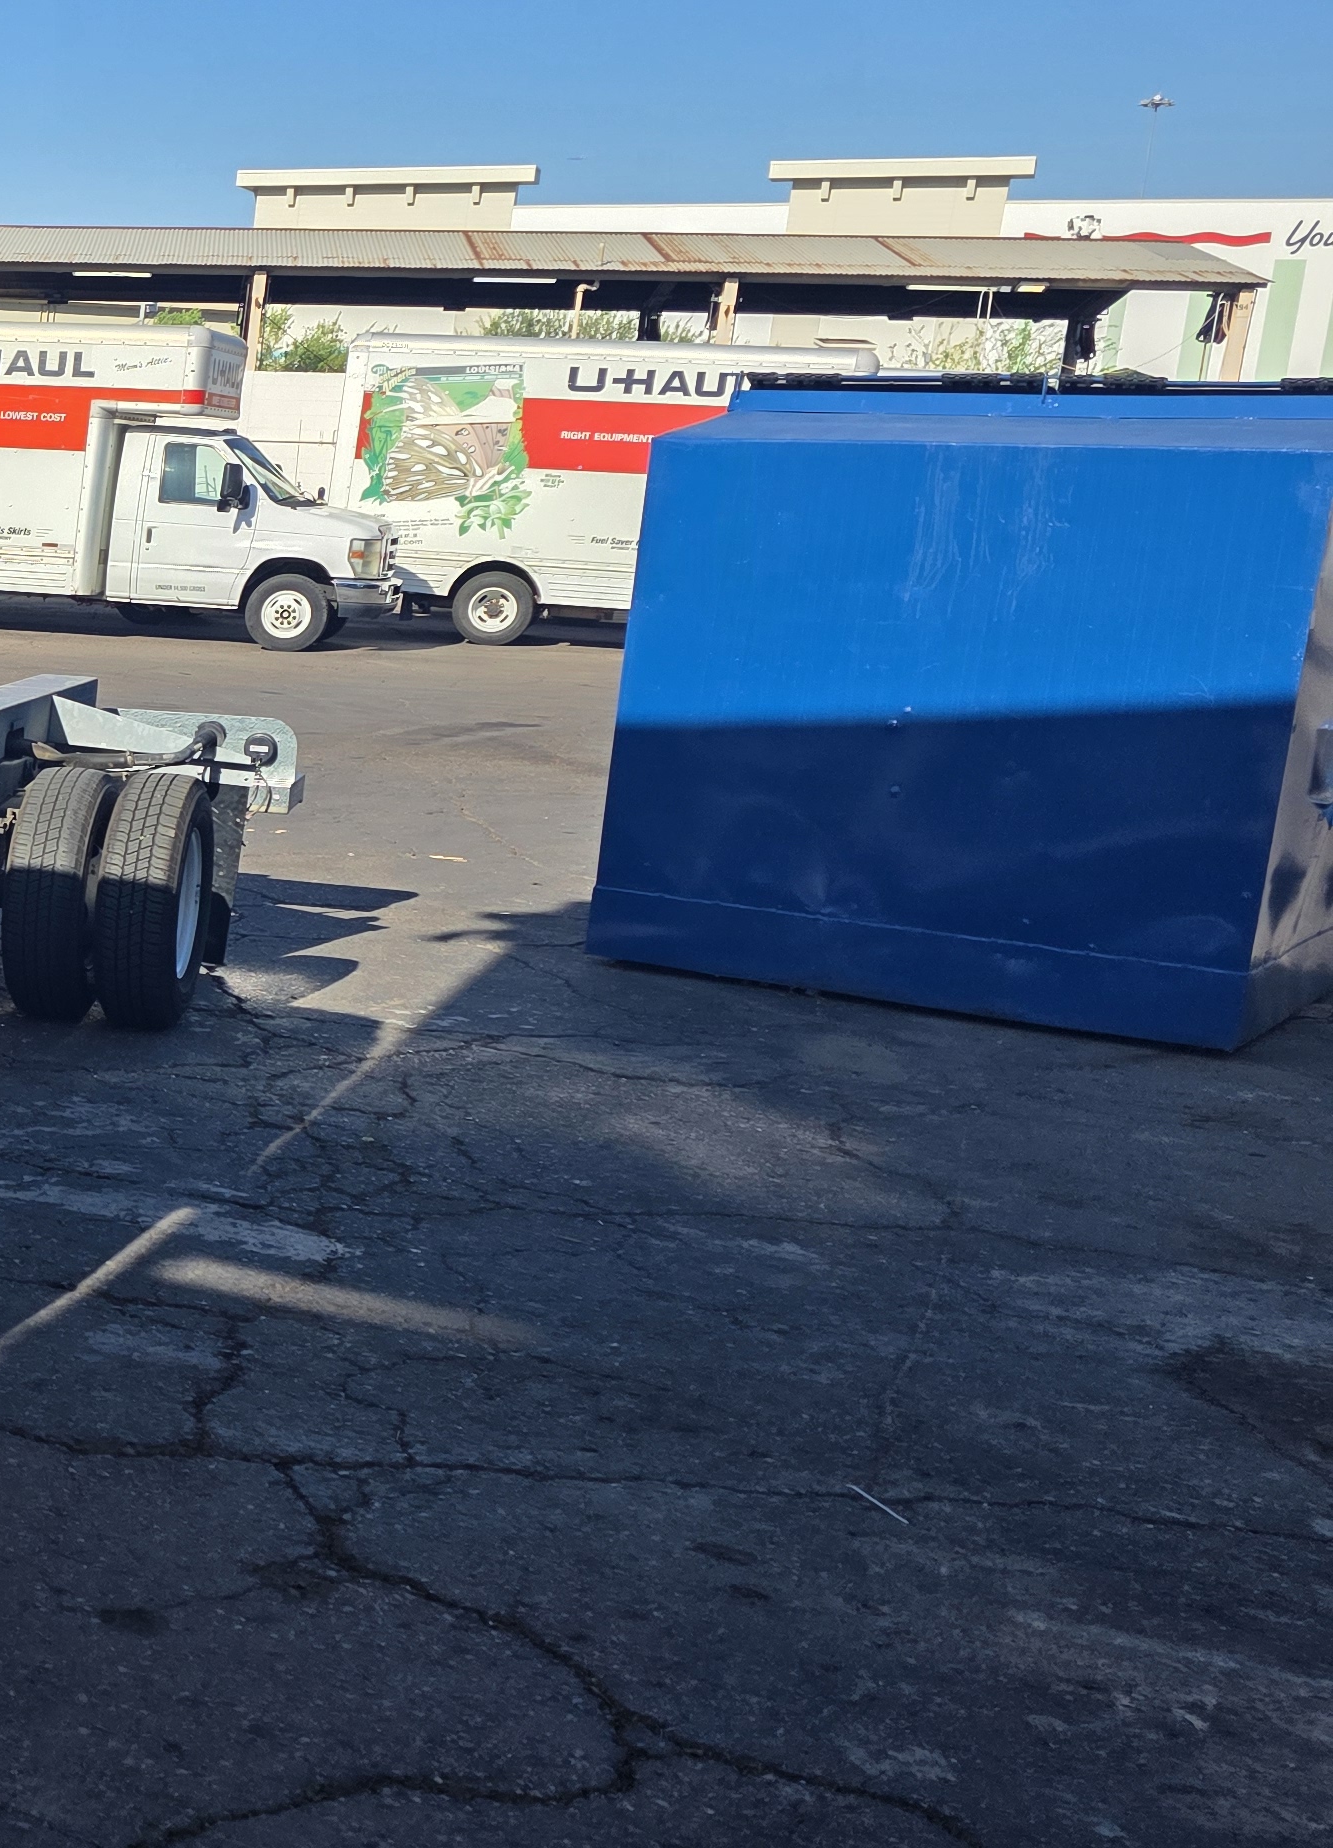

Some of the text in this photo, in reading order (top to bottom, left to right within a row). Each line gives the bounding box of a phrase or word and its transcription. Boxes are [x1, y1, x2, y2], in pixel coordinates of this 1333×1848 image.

[465, 364, 521, 375] LOUISIANA
[568, 366, 743, 398] U-HAU
[0, 411, 39, 421] LOWEST
[40, 413, 66, 422] COST
[560, 431, 654, 443] RIGHT EQUIPMENT
[6, 527, 32, 536] Skirts
[590, 536, 610, 544] Fuel
[609, 537, 635, 546] Saver
